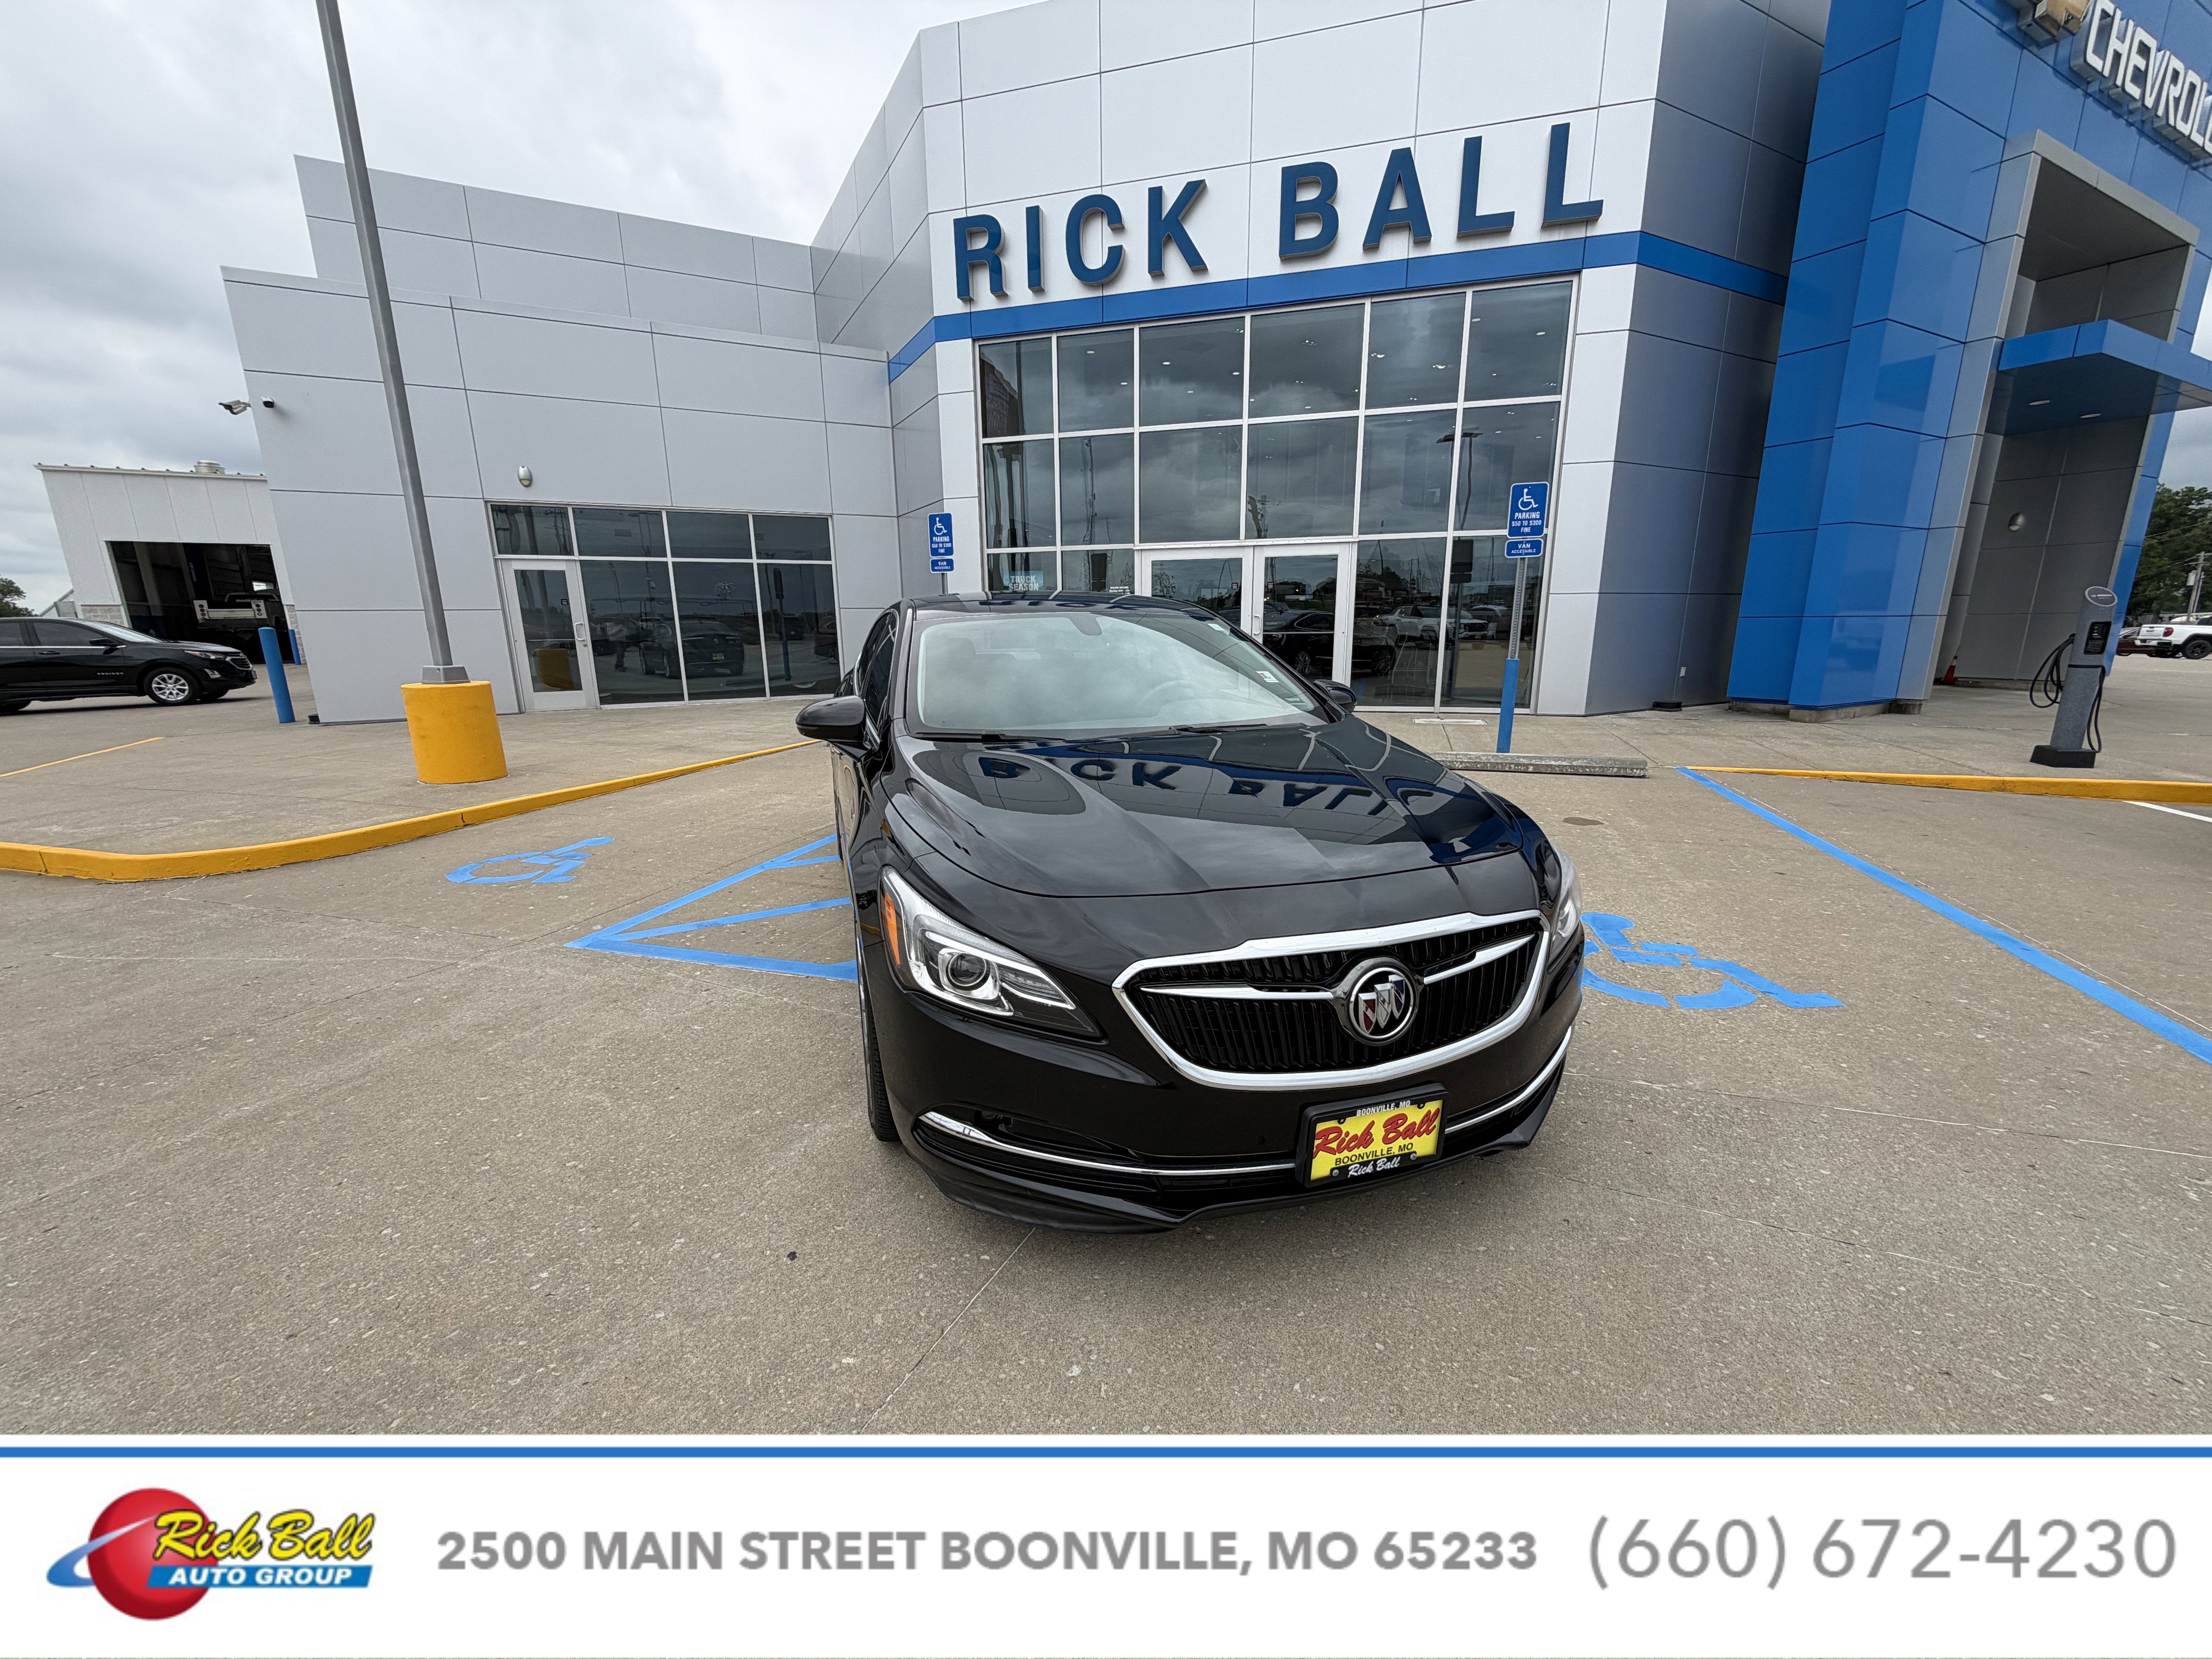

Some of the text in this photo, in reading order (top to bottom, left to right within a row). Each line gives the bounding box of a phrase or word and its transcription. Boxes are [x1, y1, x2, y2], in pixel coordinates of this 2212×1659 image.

[2086, 0, 2212, 154] CHEVROL
[952, 122, 1603, 302] RICK BALL
[1008, 583, 1039, 592] SEASON
[1010, 575, 1036, 584] TRUCK
[1356, 1103, 1397, 1116] BOONVILLE,
[1313, 1107, 1440, 1159] Rick Ball
[1398, 1142, 1413, 1152] MO
[1348, 1156, 1401, 1178] Rick Ball
